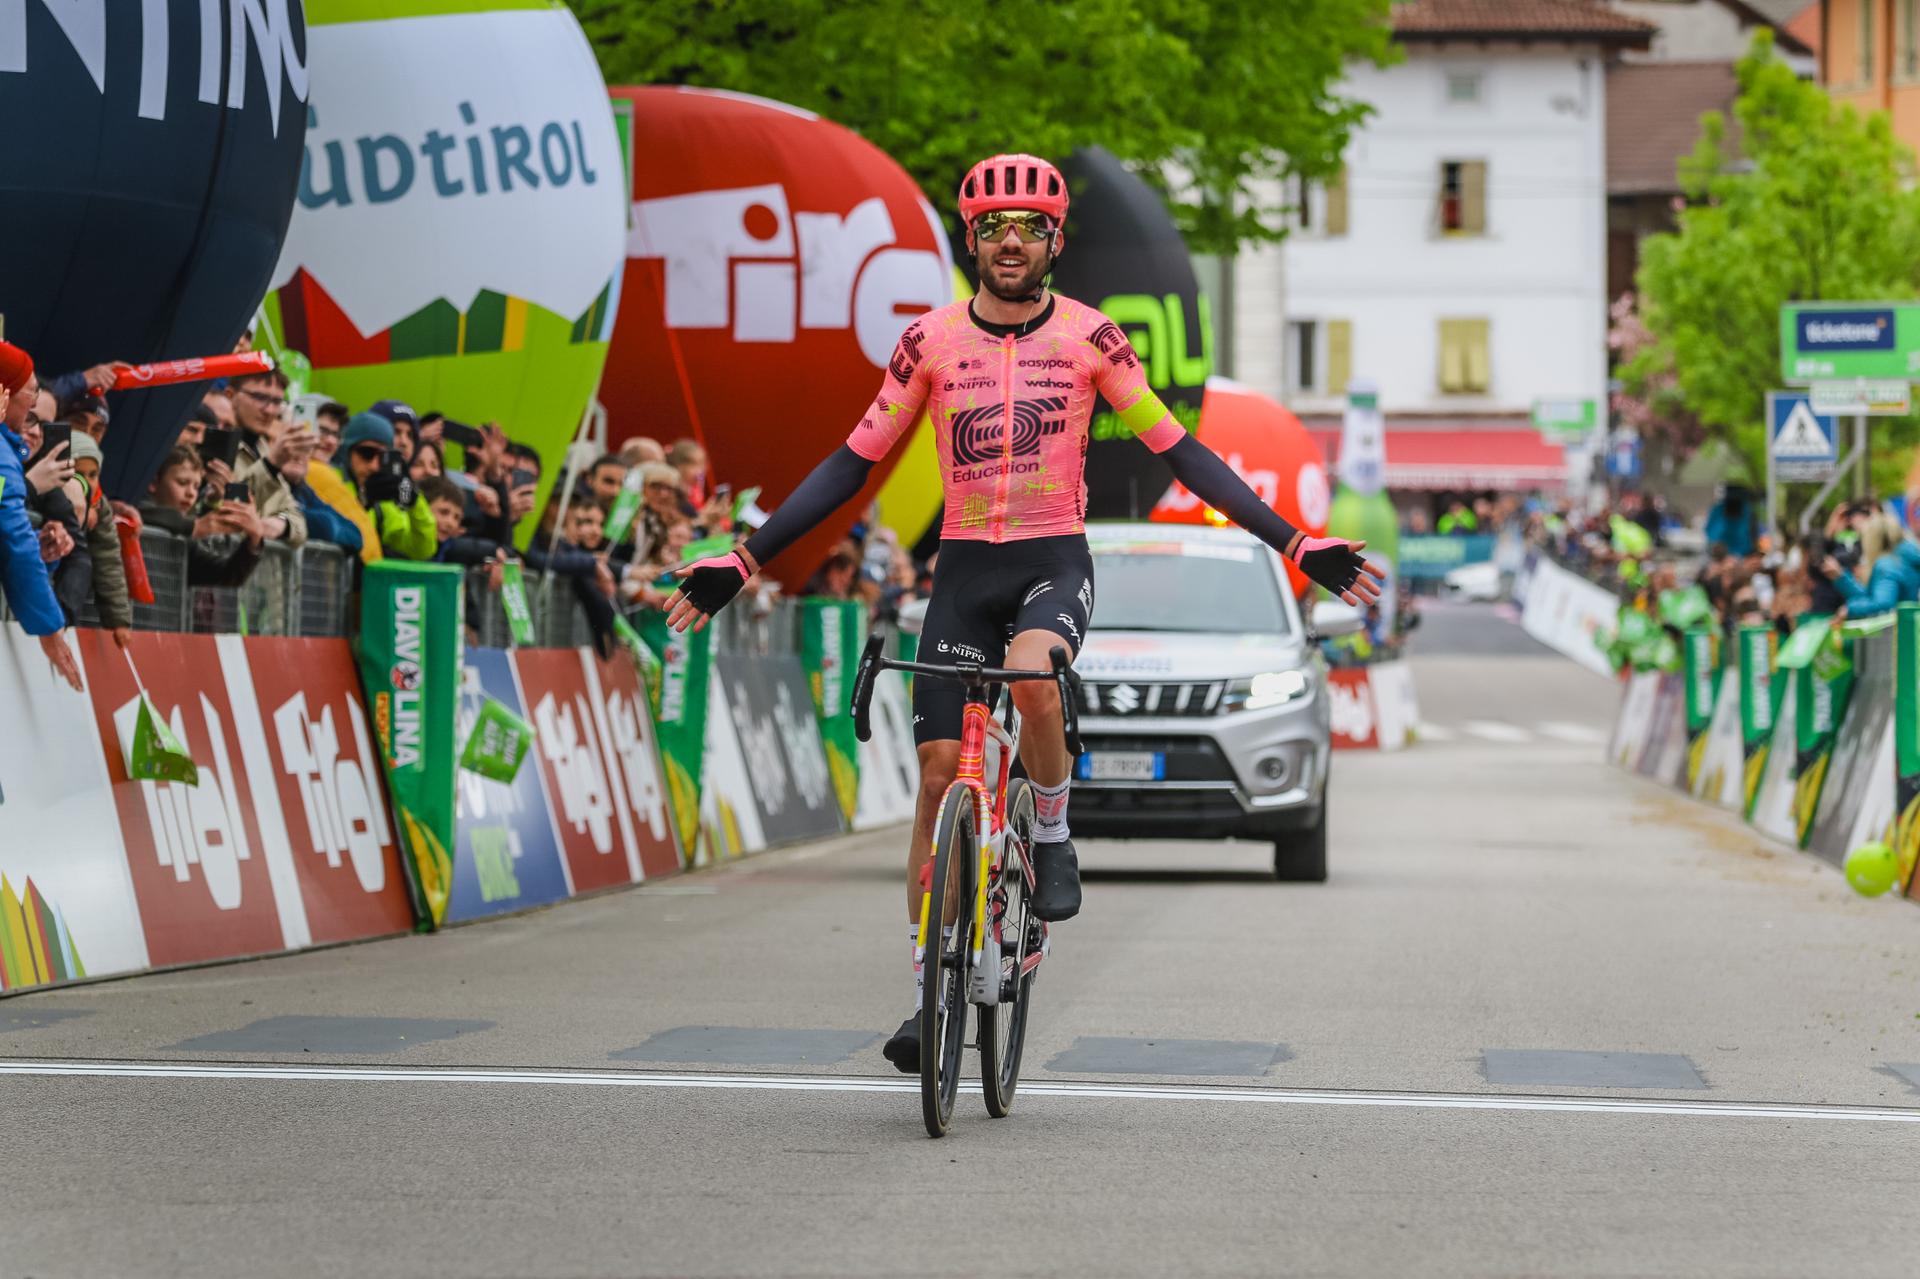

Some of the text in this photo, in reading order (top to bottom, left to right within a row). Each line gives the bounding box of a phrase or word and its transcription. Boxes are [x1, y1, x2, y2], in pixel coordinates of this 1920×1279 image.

[1018, 359, 1074, 371] easypost
[957, 380, 996, 390] NIPPO
[1024, 378, 1074, 389] wahoo
[953, 461, 1040, 483] Education
[951, 646, 986, 663] NIPPO
[393, 586, 422, 768] DIAVOLINA
